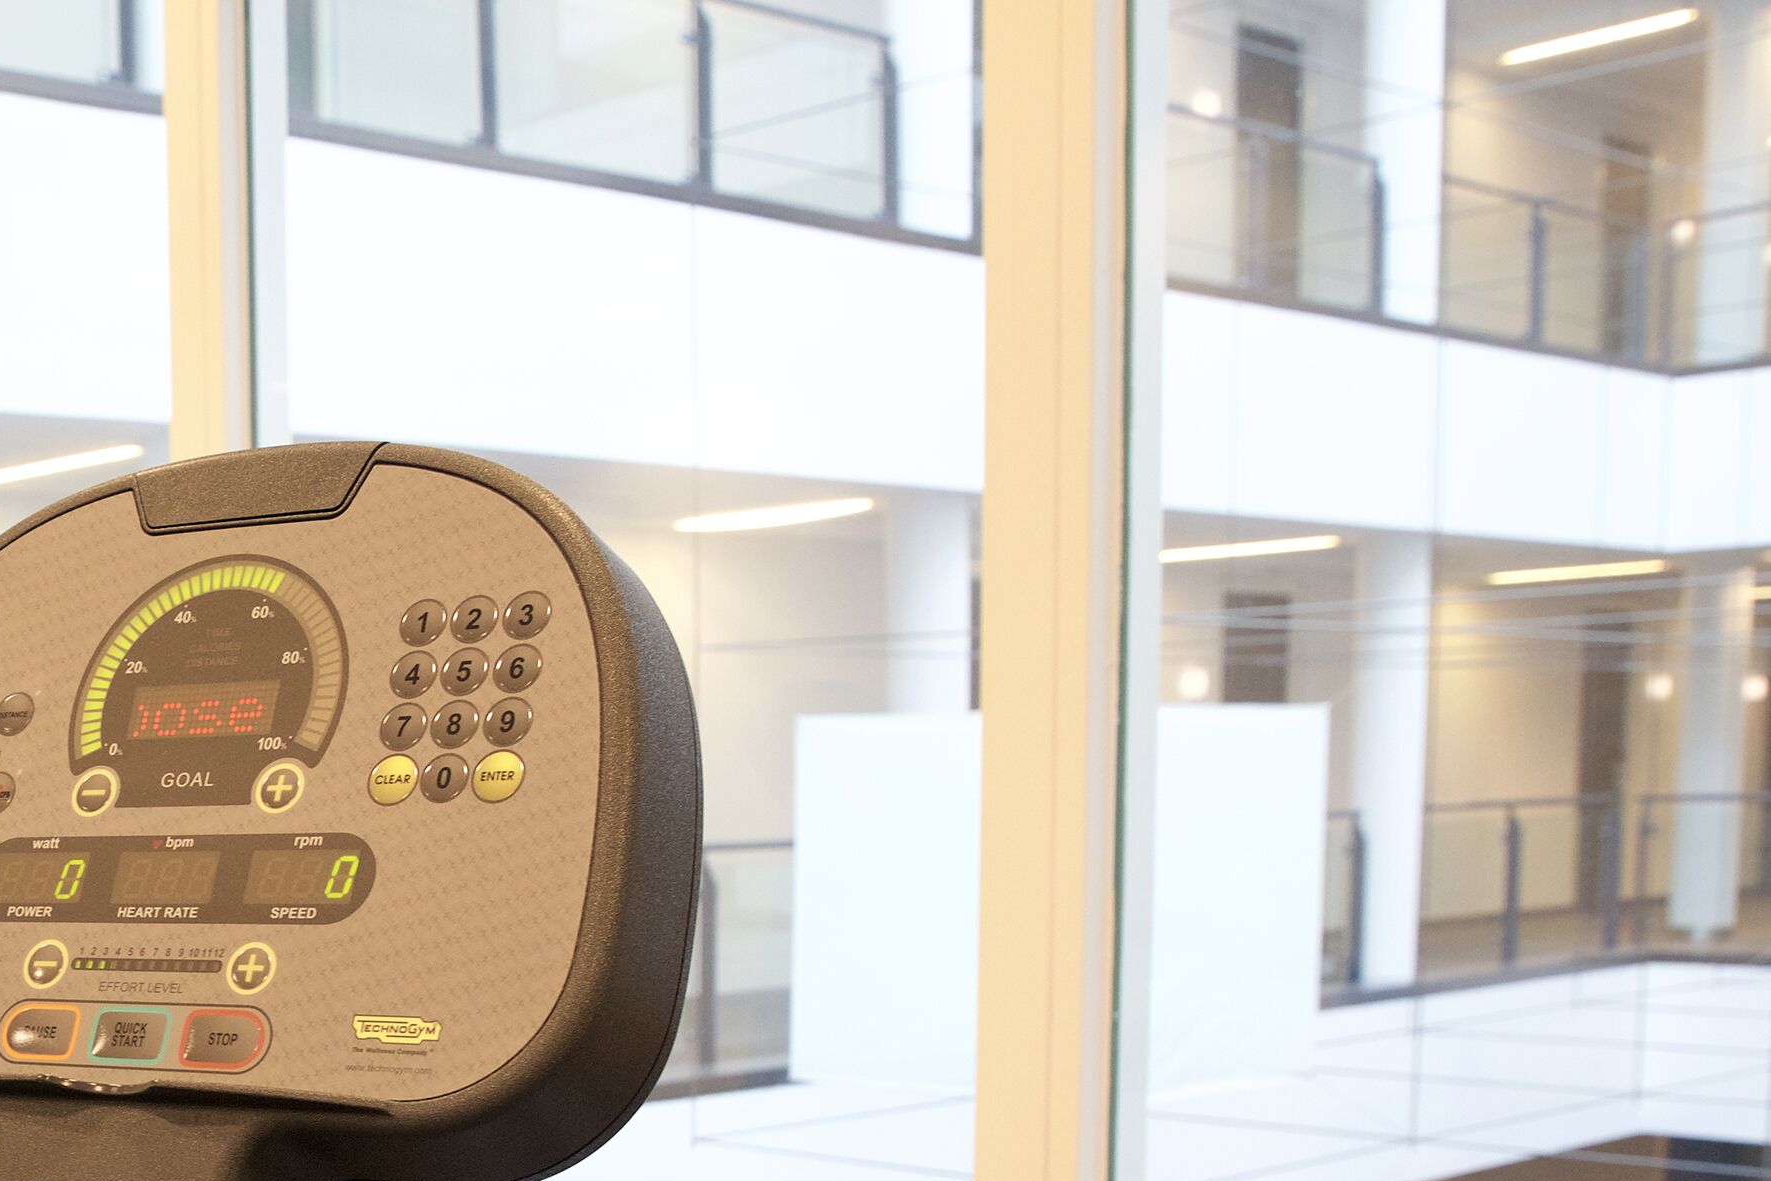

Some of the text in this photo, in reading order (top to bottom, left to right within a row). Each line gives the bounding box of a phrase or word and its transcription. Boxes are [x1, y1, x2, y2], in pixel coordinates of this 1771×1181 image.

[417, 604, 534, 633] 1 2 3
[404, 656, 525, 685] 4 5 6
[396, 710, 516, 737] 7 8 9
[160, 771, 214, 788] GOAL
[374, 774, 411, 785] CLEAR
[436, 766, 452, 789] 0
[480, 770, 515, 782] ENTER
[32, 837, 60, 849] watt
[165, 836, 194, 850] bpm
[293, 835, 323, 849] rpm
[54, 859, 86, 900] 0
[324, 855, 360, 899] 0
[6, 906, 52, 917] POWER
[117, 906, 198, 918] HEART RATE
[270, 907, 317, 919] SPEED
[98, 981, 183, 994] EFFORT LEVEL
[114, 1022, 148, 1035] QUICK
[111, 1034, 145, 1048] START
[208, 1032, 238, 1046] STOP
